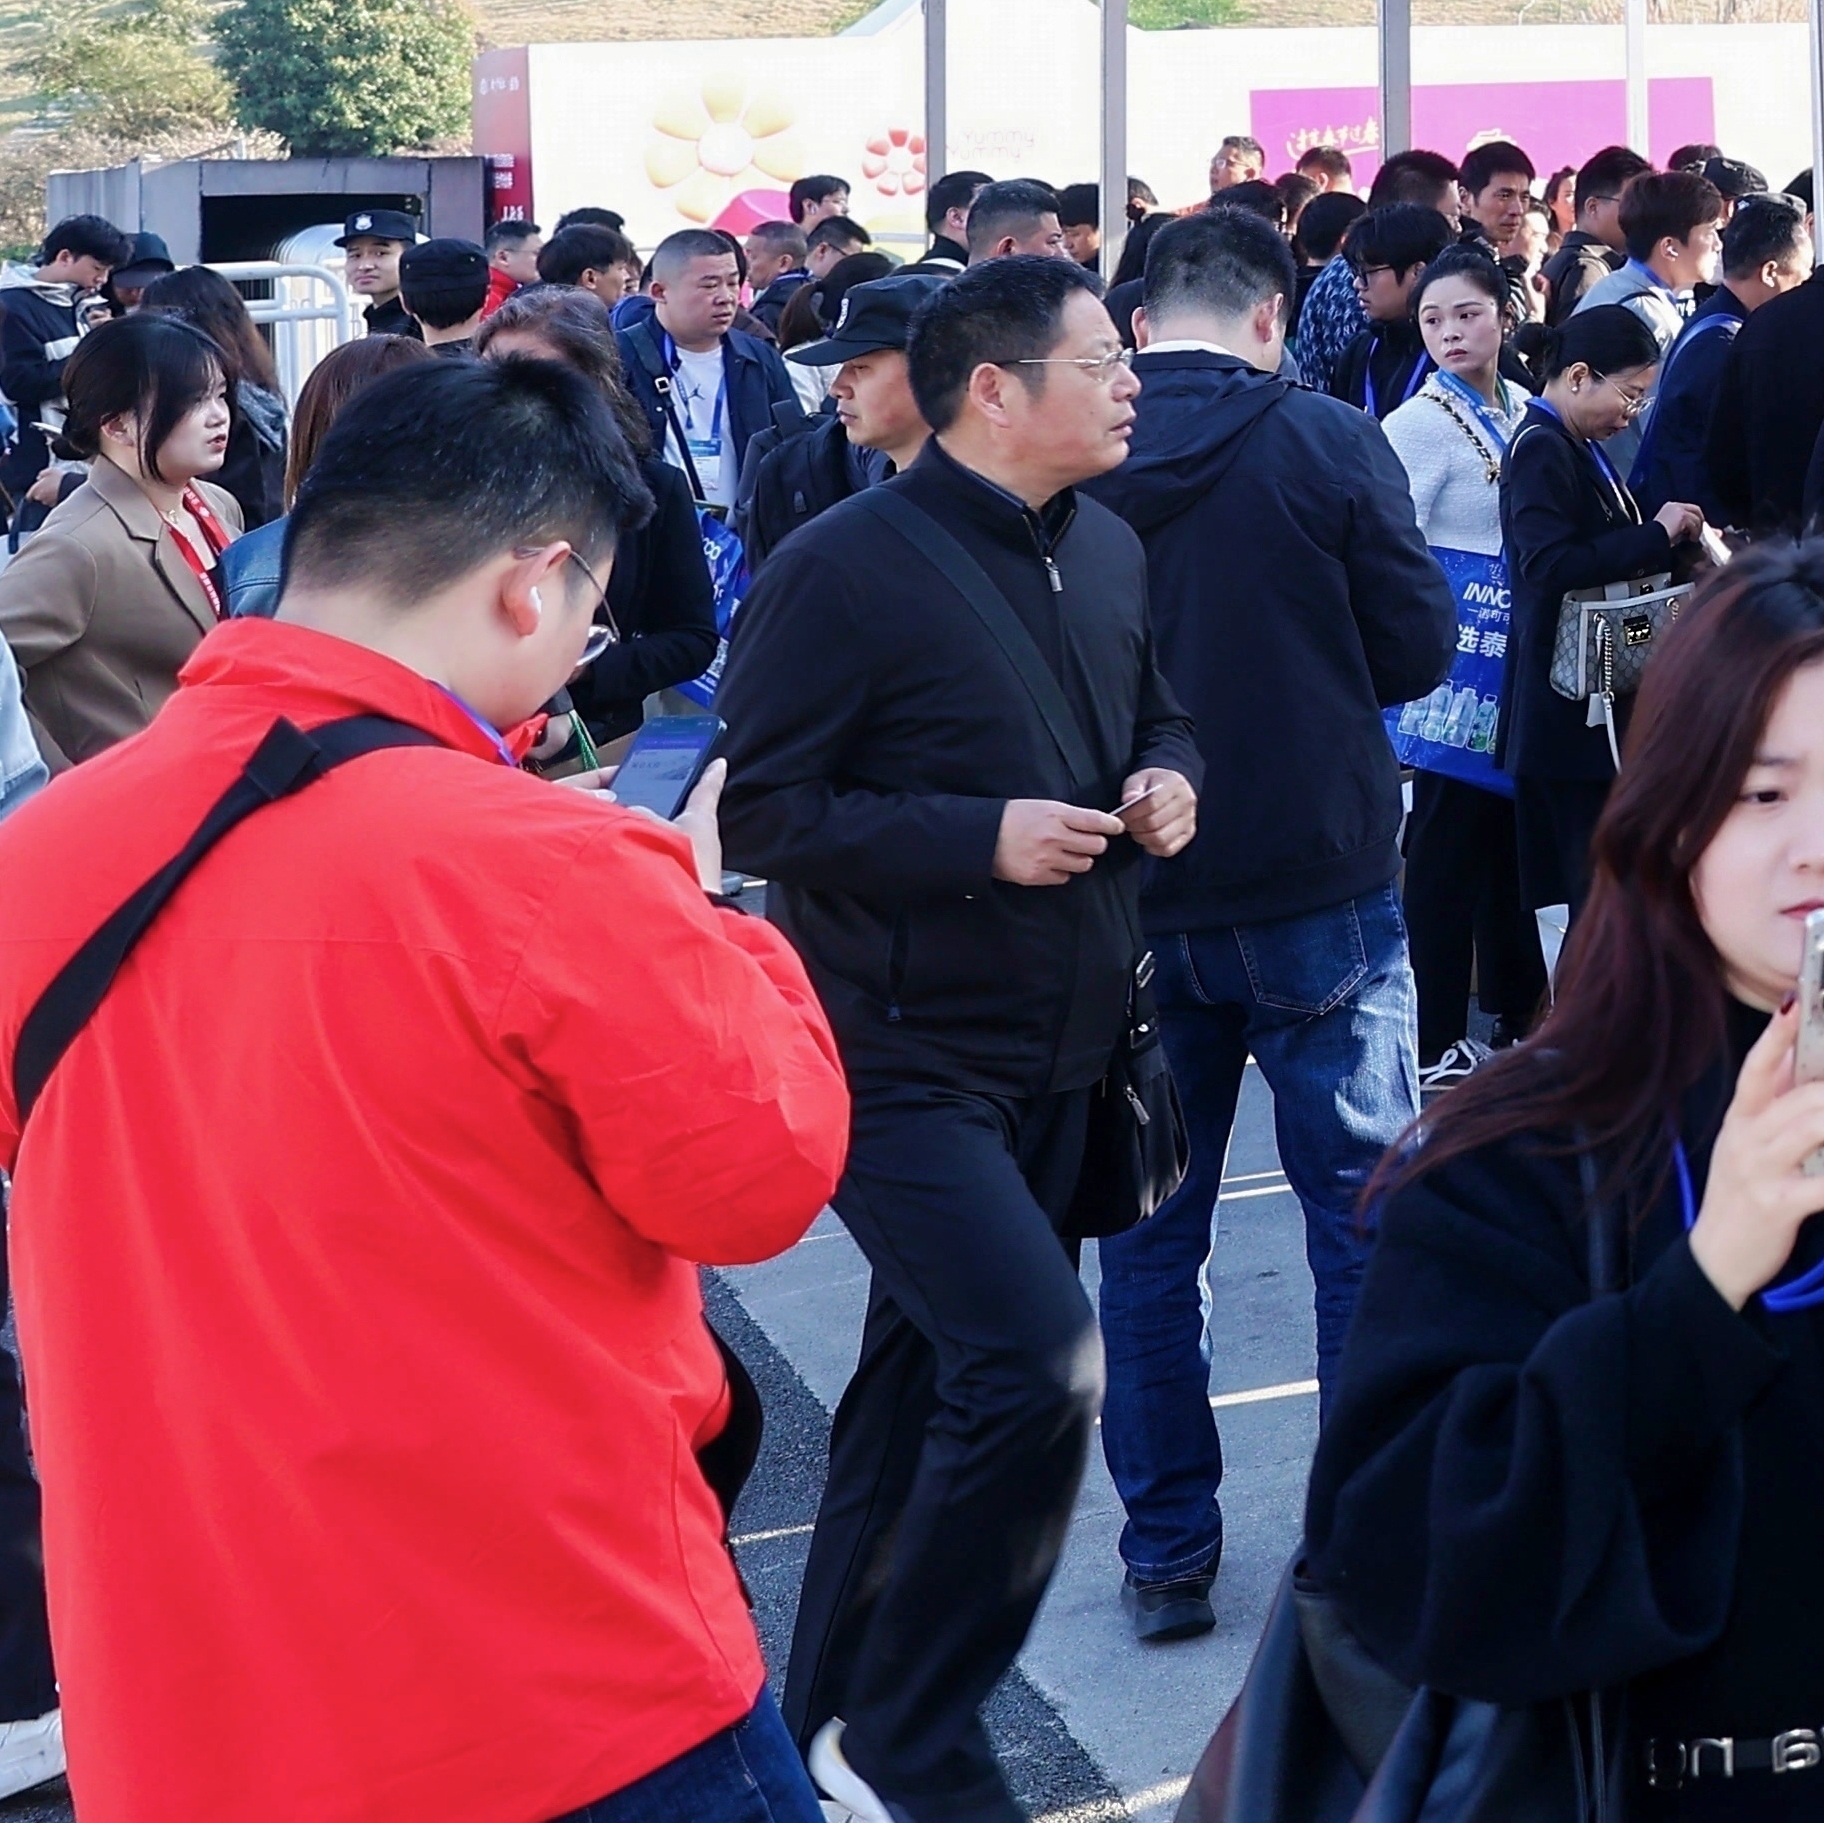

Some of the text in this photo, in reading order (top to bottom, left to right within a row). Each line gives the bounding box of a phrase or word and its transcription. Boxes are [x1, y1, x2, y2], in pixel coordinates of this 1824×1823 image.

[1287, 117, 1379, 158] 过完春节过春
